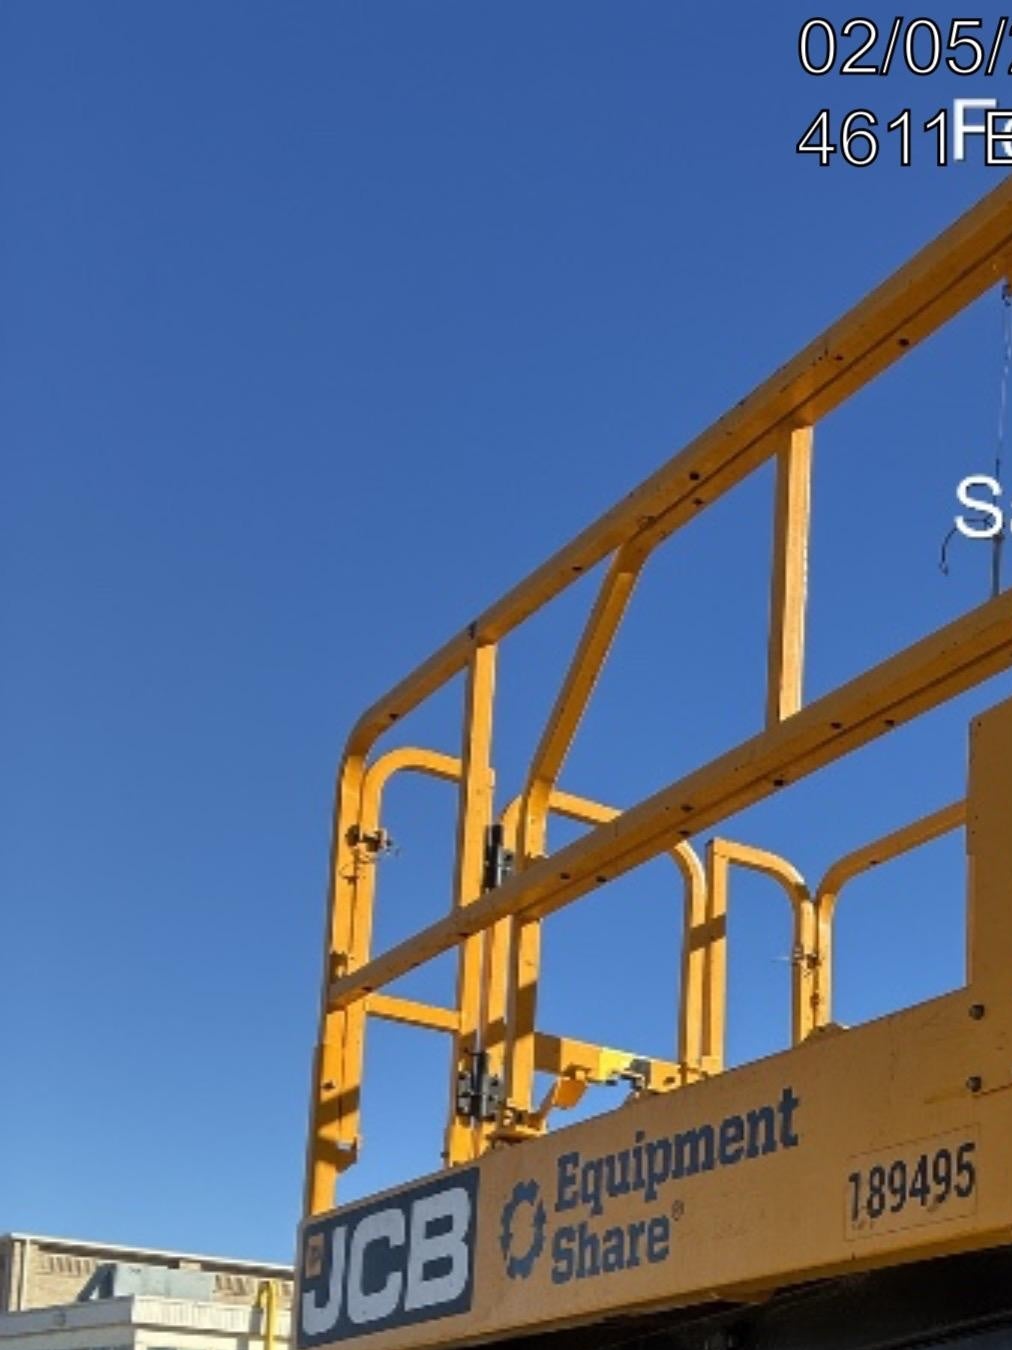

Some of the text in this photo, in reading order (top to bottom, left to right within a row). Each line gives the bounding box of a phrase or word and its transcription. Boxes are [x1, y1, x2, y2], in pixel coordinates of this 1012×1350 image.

[554, 1086, 799, 1217] Equipment
[848, 1141, 976, 1222] 189495
[302, 1186, 472, 1336] JCB
